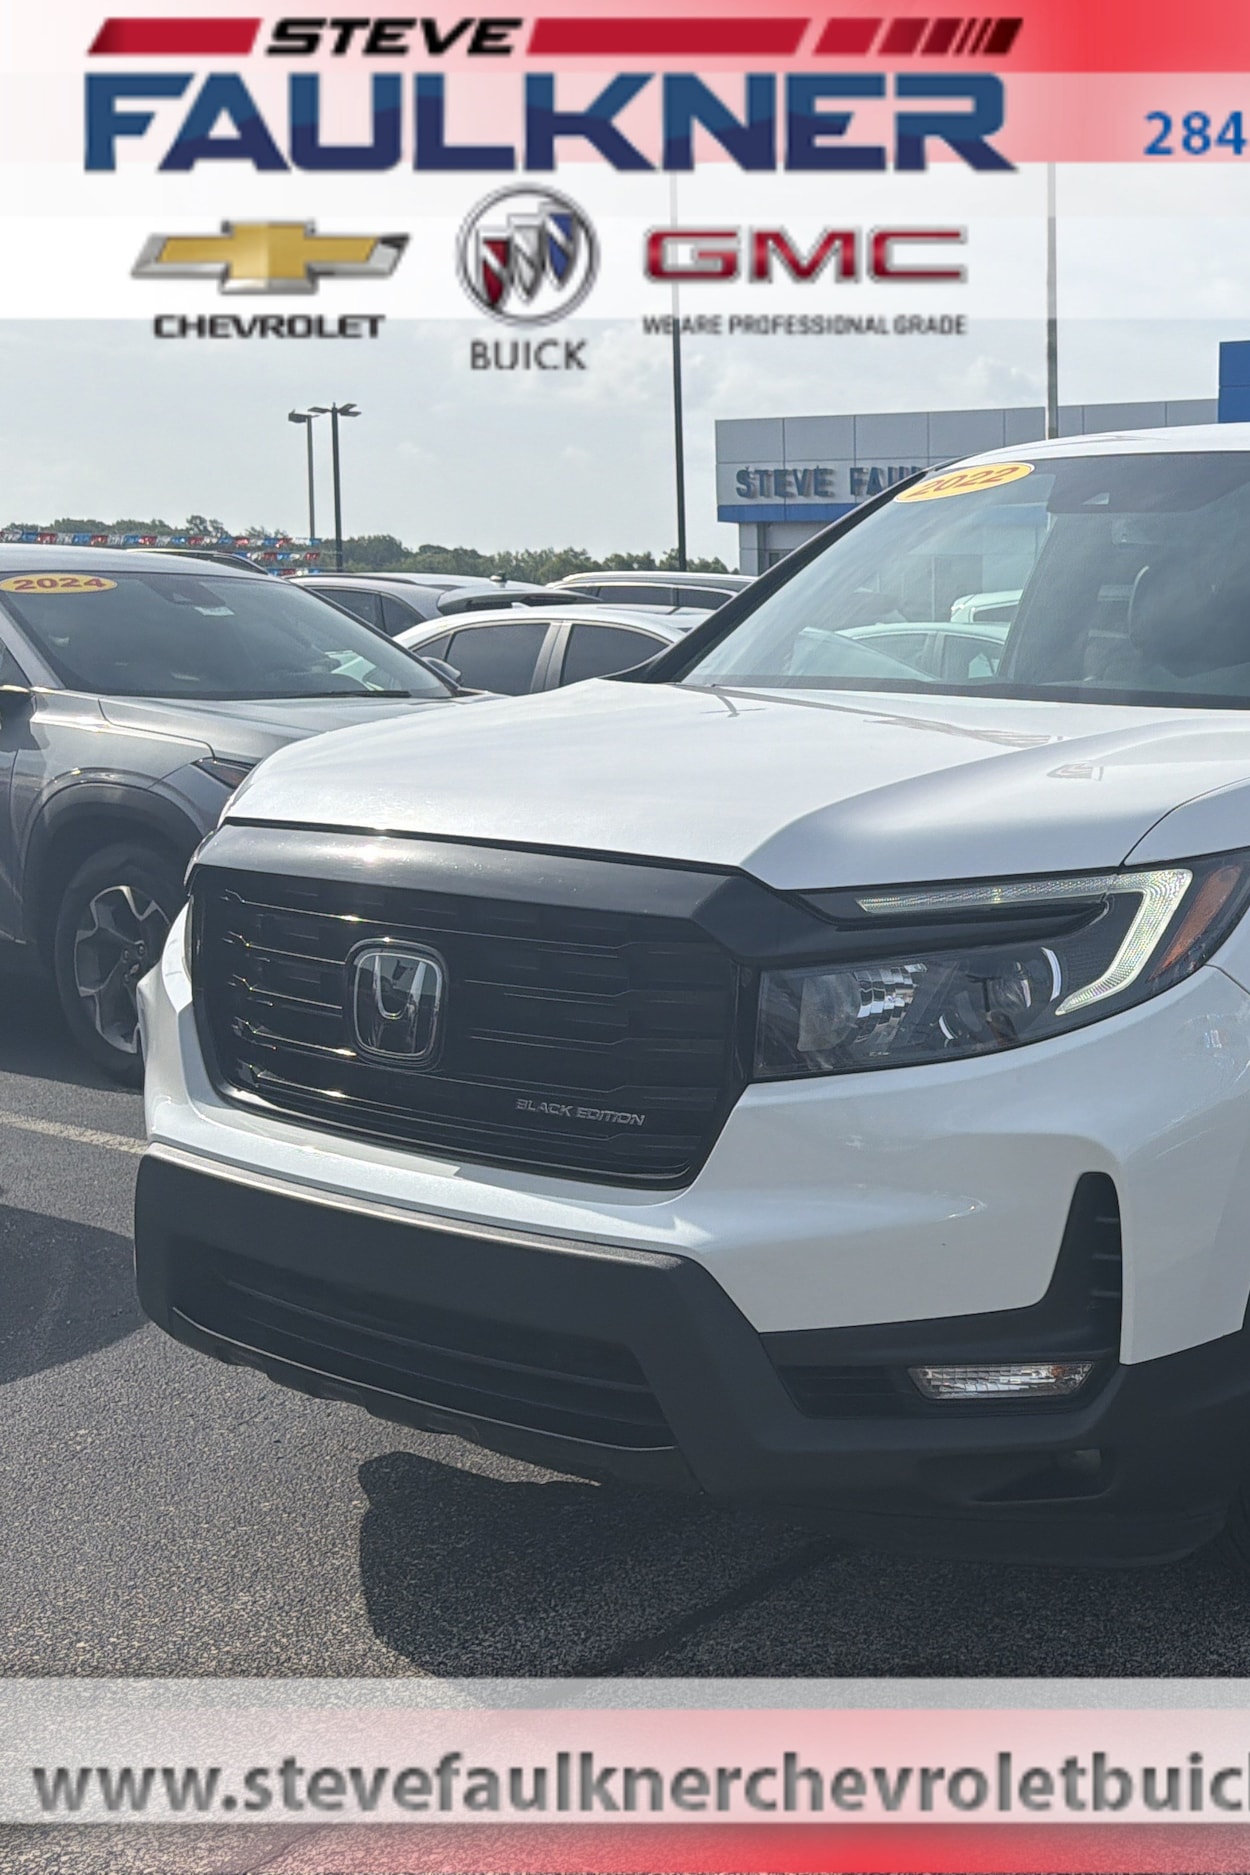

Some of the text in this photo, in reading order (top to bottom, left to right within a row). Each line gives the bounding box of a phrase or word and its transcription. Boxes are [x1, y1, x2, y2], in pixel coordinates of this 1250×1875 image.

[736, 468, 836, 498] STEVE
[905, 466, 1020, 498] 2022
[13, 577, 107, 591] 2024
[516, 1098, 646, 1127] BLACK EDITION
